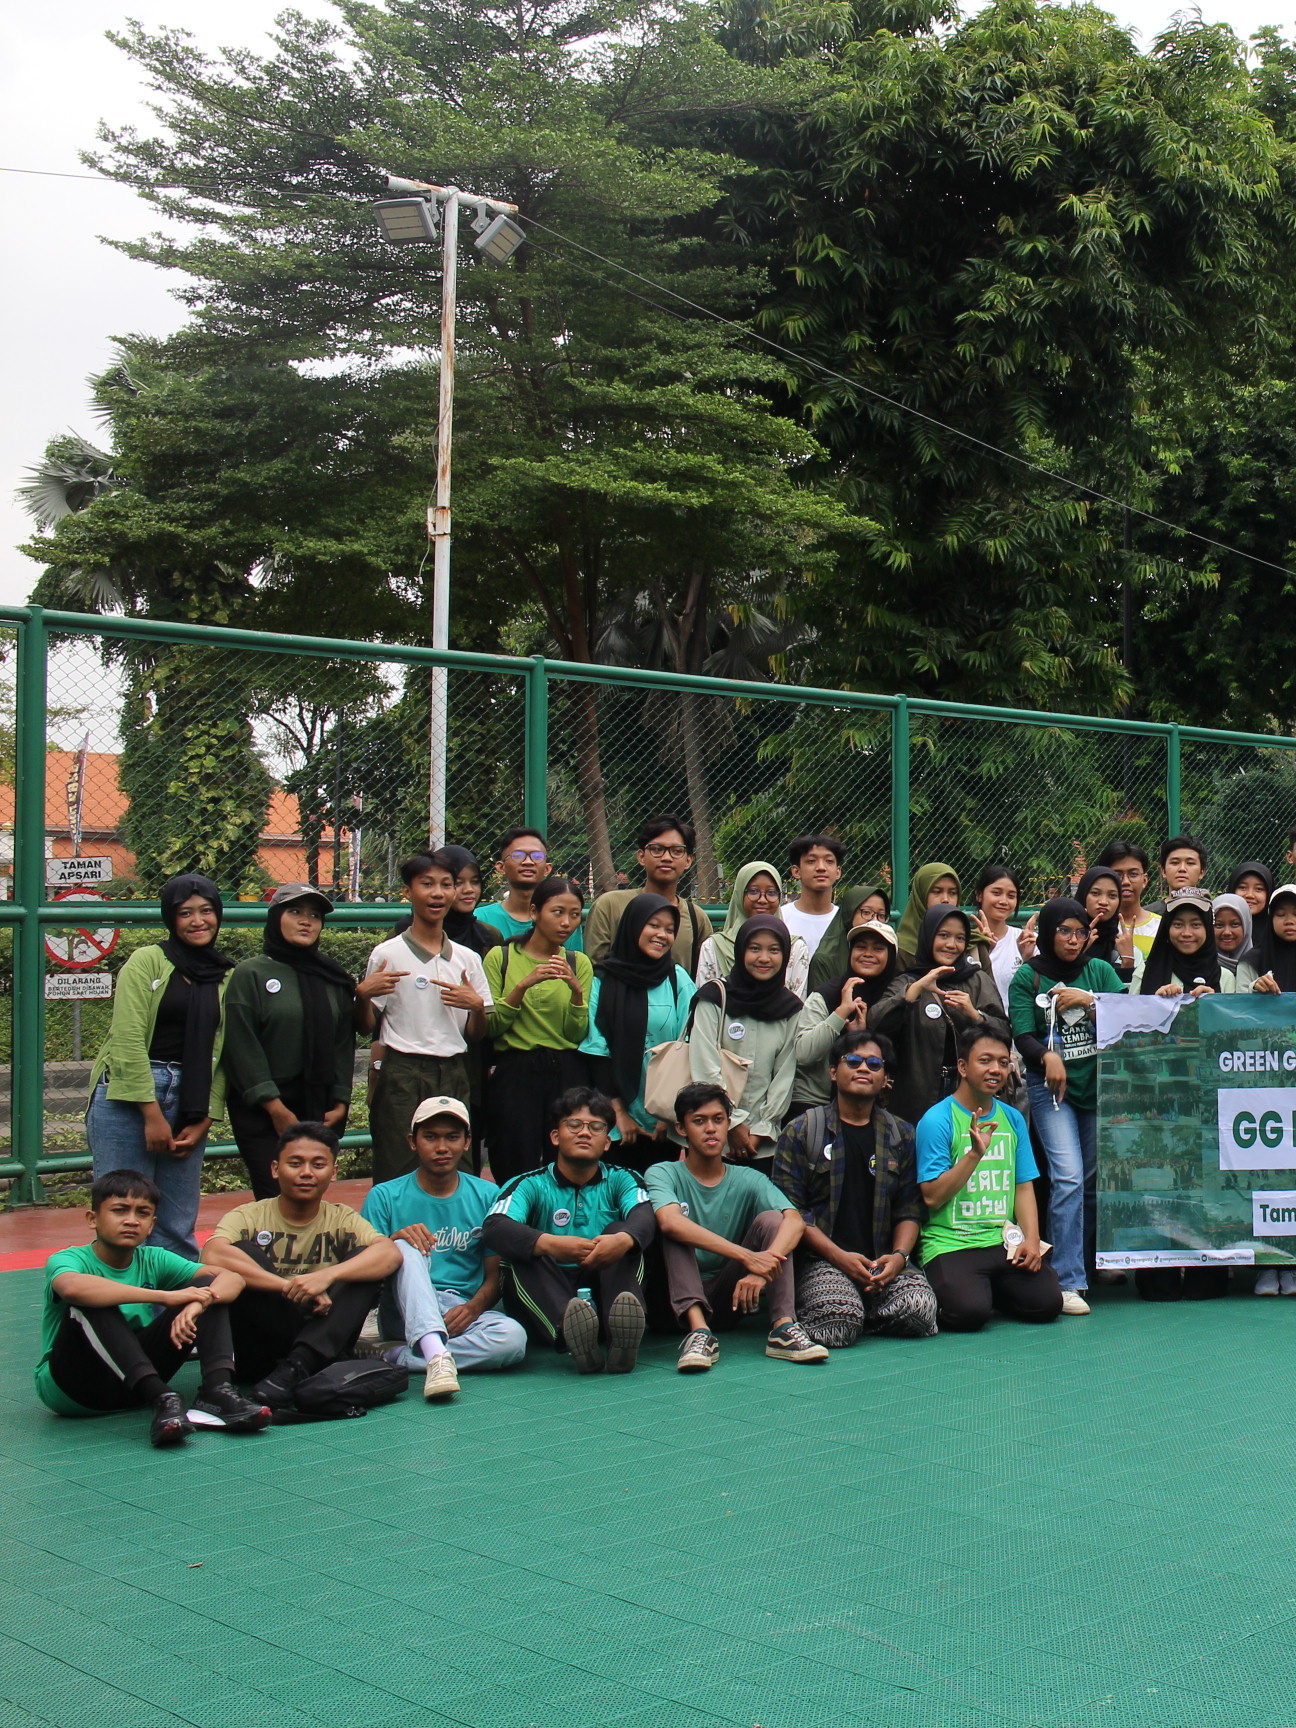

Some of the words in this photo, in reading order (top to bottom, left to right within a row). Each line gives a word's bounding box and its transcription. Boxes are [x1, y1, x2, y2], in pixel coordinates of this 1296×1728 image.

[59, 870, 101, 881] APSARI
[62, 860, 102, 870] TAMAN
[57, 977, 101, 985] DILARANG
[1219, 1050, 1279, 1072] GREEN
[1233, 1110, 1284, 1149] GG
[967, 1169, 1012, 1193] EACE
[959, 1194, 1007, 1217] שלום
[433, 1226, 472, 1252] tions
